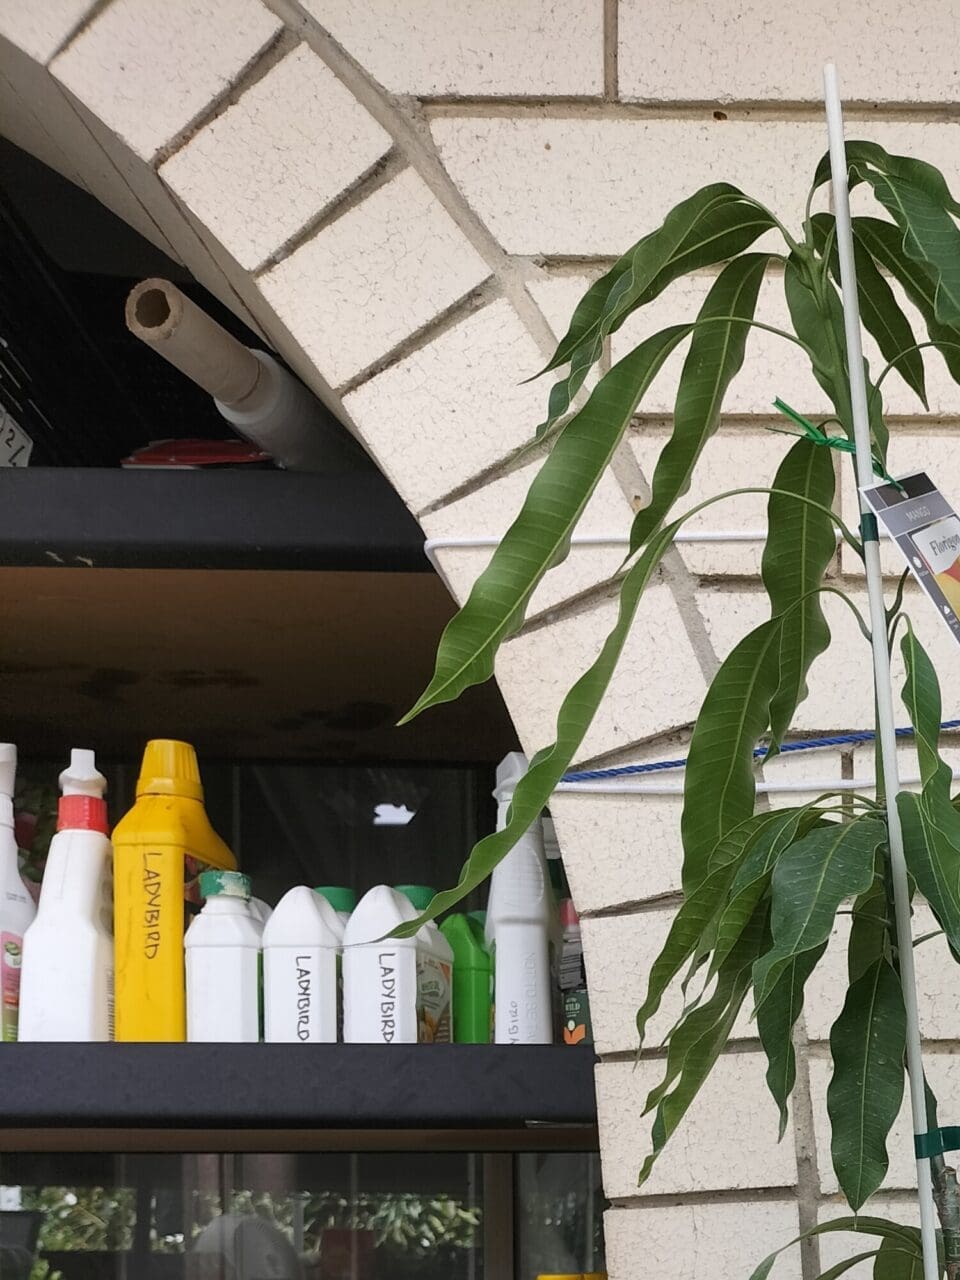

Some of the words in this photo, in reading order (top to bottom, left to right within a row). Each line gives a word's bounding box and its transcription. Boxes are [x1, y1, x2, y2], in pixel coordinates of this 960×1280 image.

[142, 852, 163, 960] LADYBIRD
[295, 955, 311, 1042] LADYBIRD
[378, 952, 396, 1043] LADYBIRD
